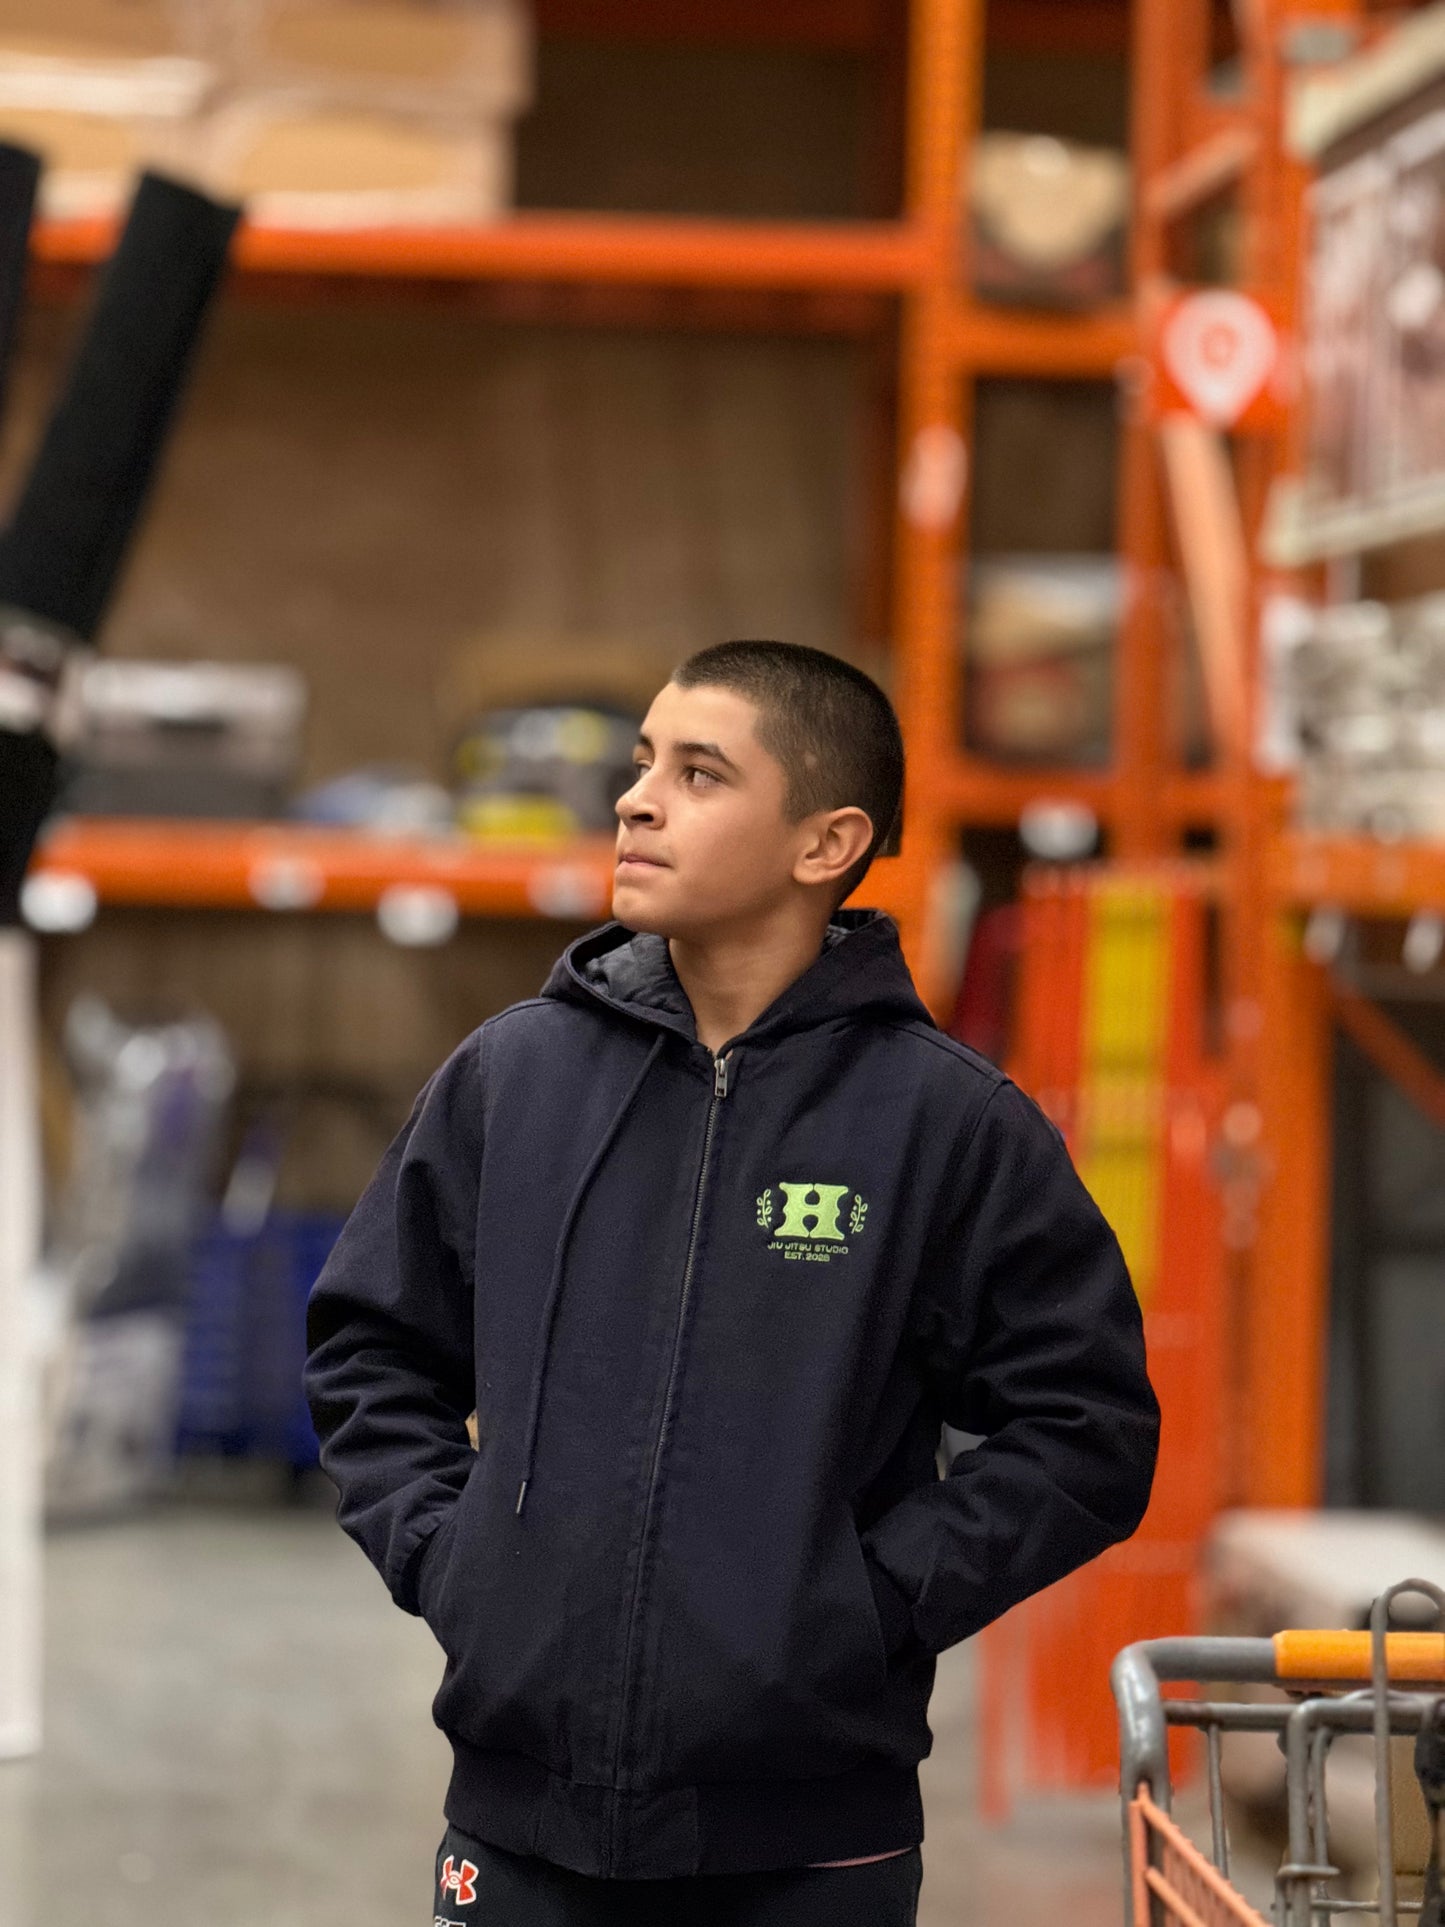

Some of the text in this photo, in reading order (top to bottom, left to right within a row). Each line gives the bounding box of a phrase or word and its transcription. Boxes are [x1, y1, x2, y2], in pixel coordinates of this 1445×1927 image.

[774, 1182, 849, 1241] H
[767, 1241, 849, 1255] JIU JITSU STUDIO
[784, 1251, 805, 1261] EST.
